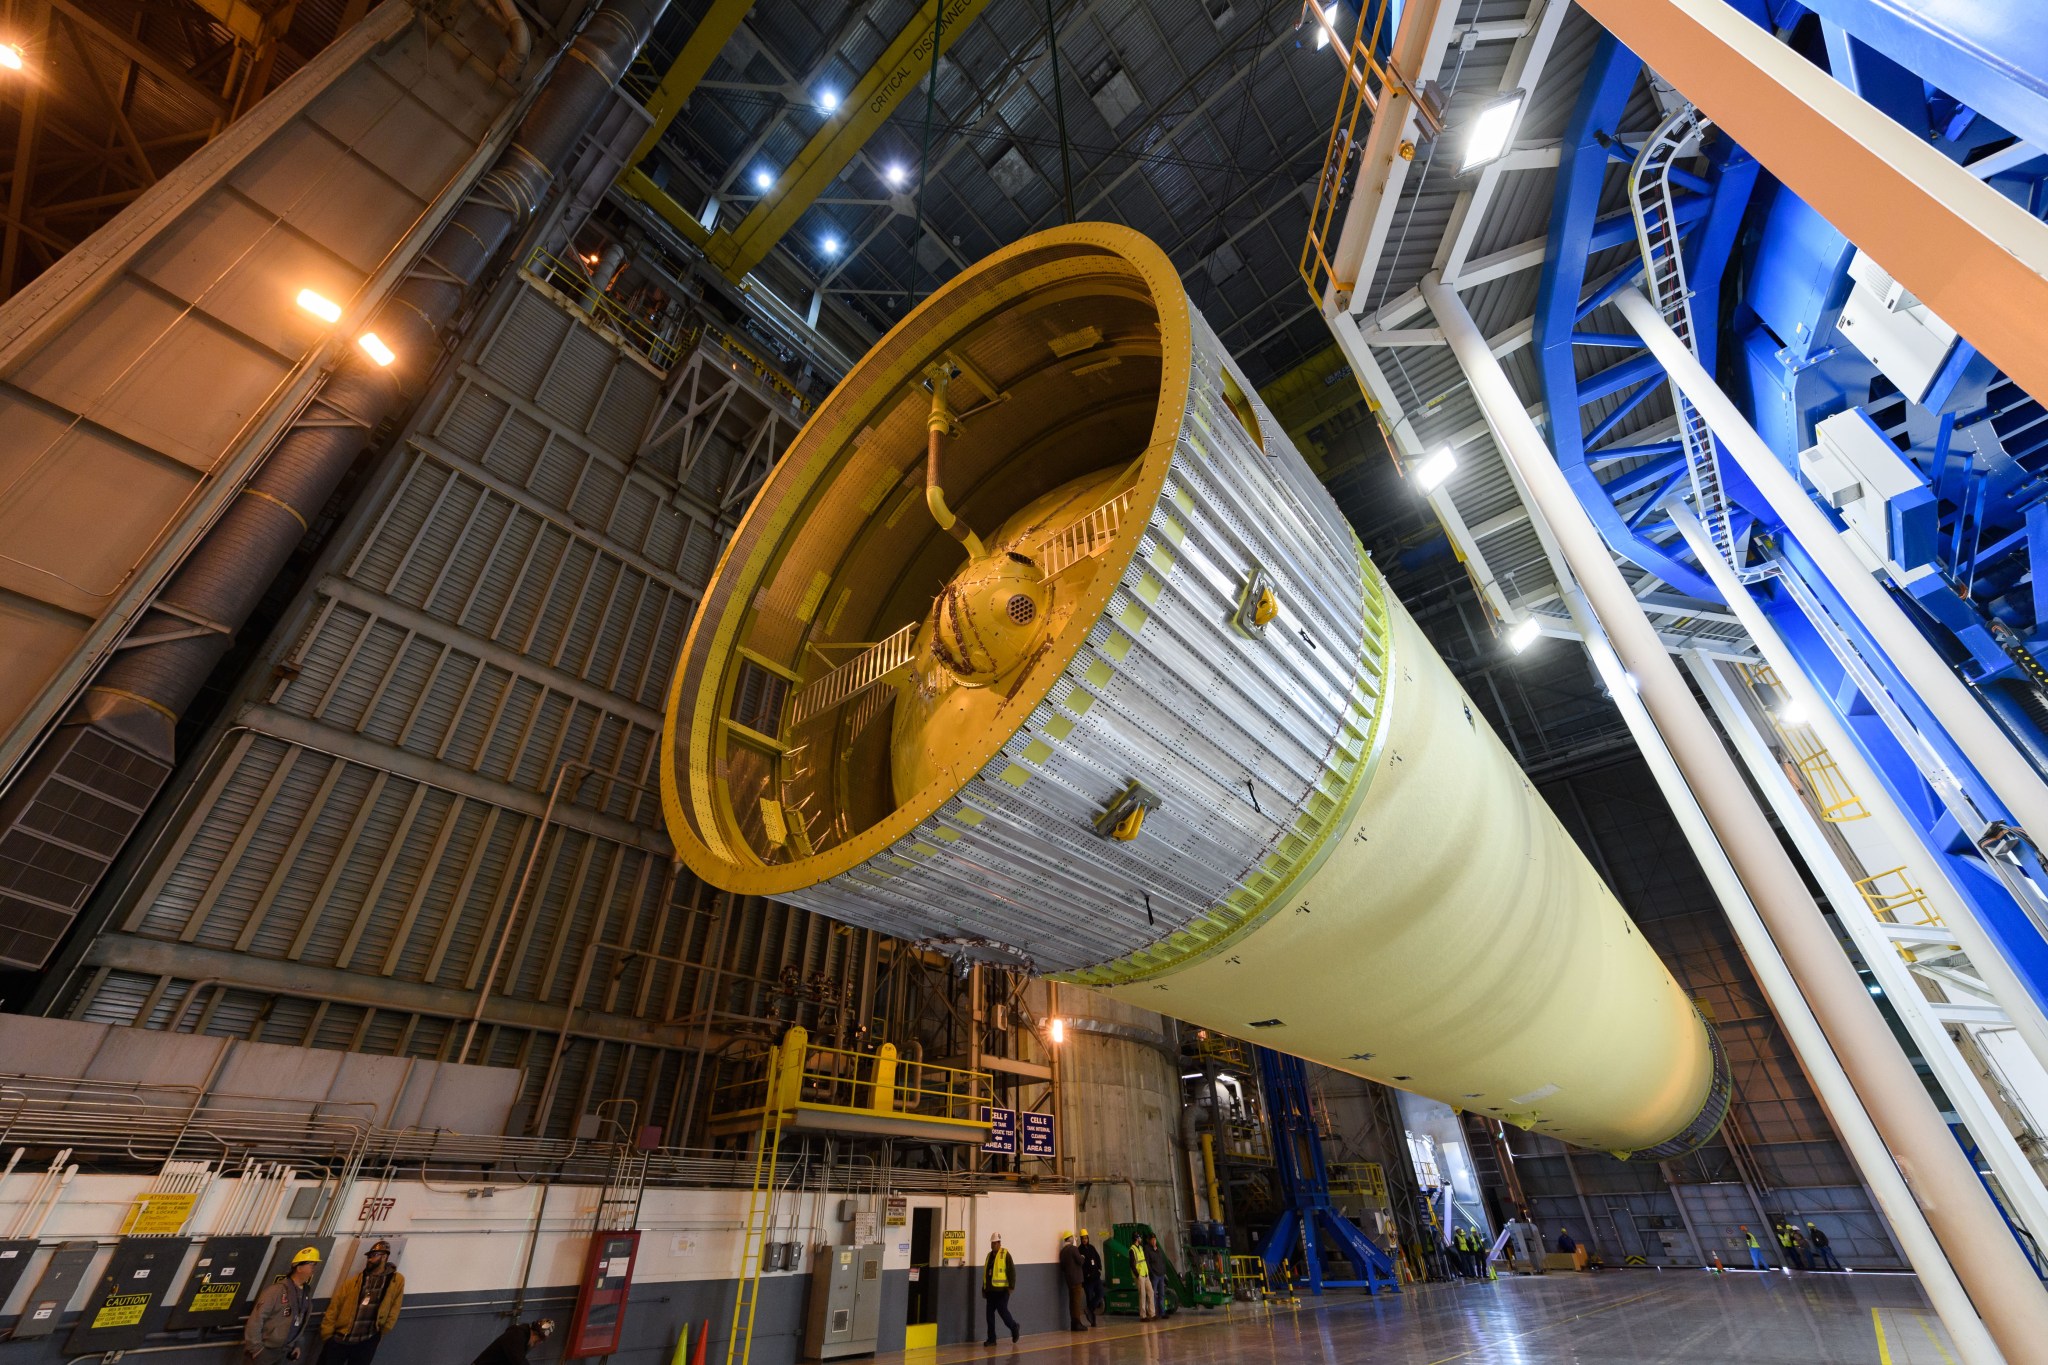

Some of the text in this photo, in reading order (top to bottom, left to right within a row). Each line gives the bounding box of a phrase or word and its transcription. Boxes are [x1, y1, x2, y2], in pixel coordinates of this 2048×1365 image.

[870, 66, 912, 114] CRITICAL
[358, 1206, 392, 1221] EXIT
[106, 1296, 148, 1307] CAUTION
